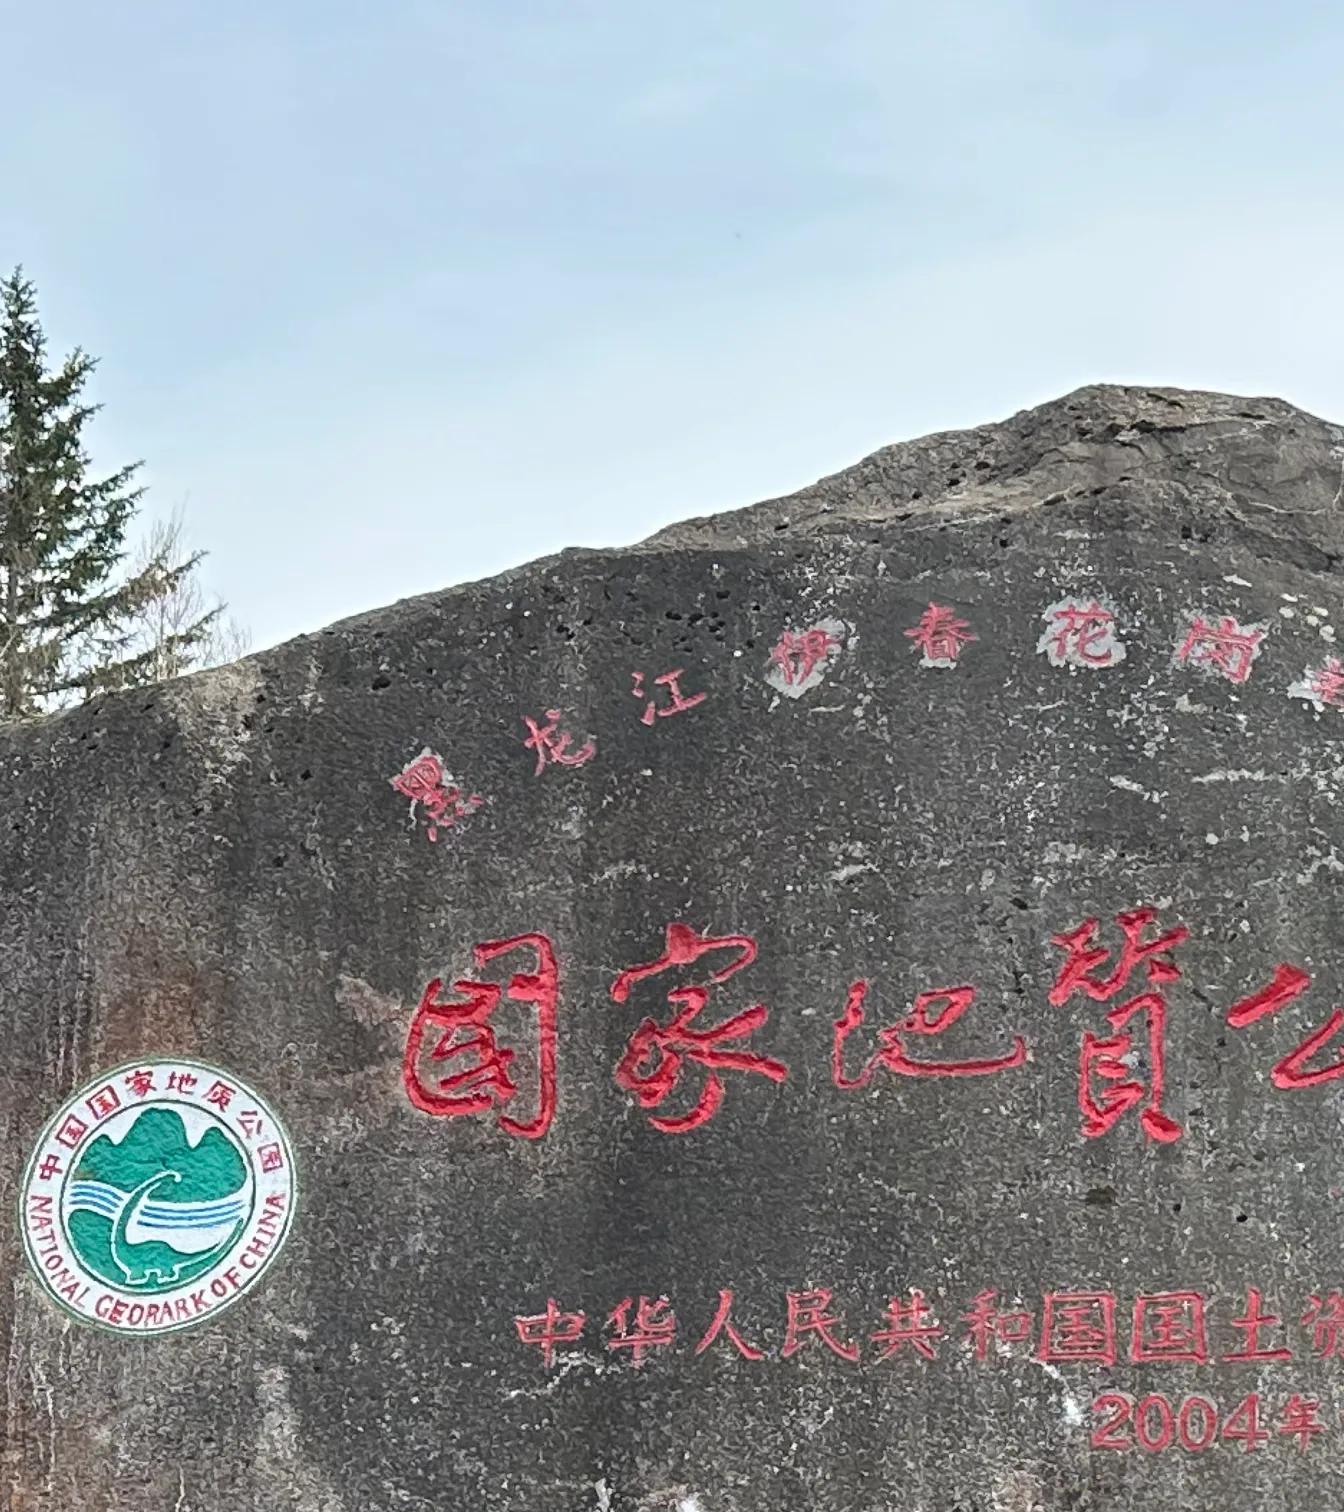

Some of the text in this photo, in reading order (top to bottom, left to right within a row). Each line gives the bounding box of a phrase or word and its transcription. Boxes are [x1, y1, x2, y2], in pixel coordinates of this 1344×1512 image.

[39, 1070, 284, 1181] 中国国家地质公园
[30, 1193, 287, 1327] NATIONAL GEOPARK OF CHINA
